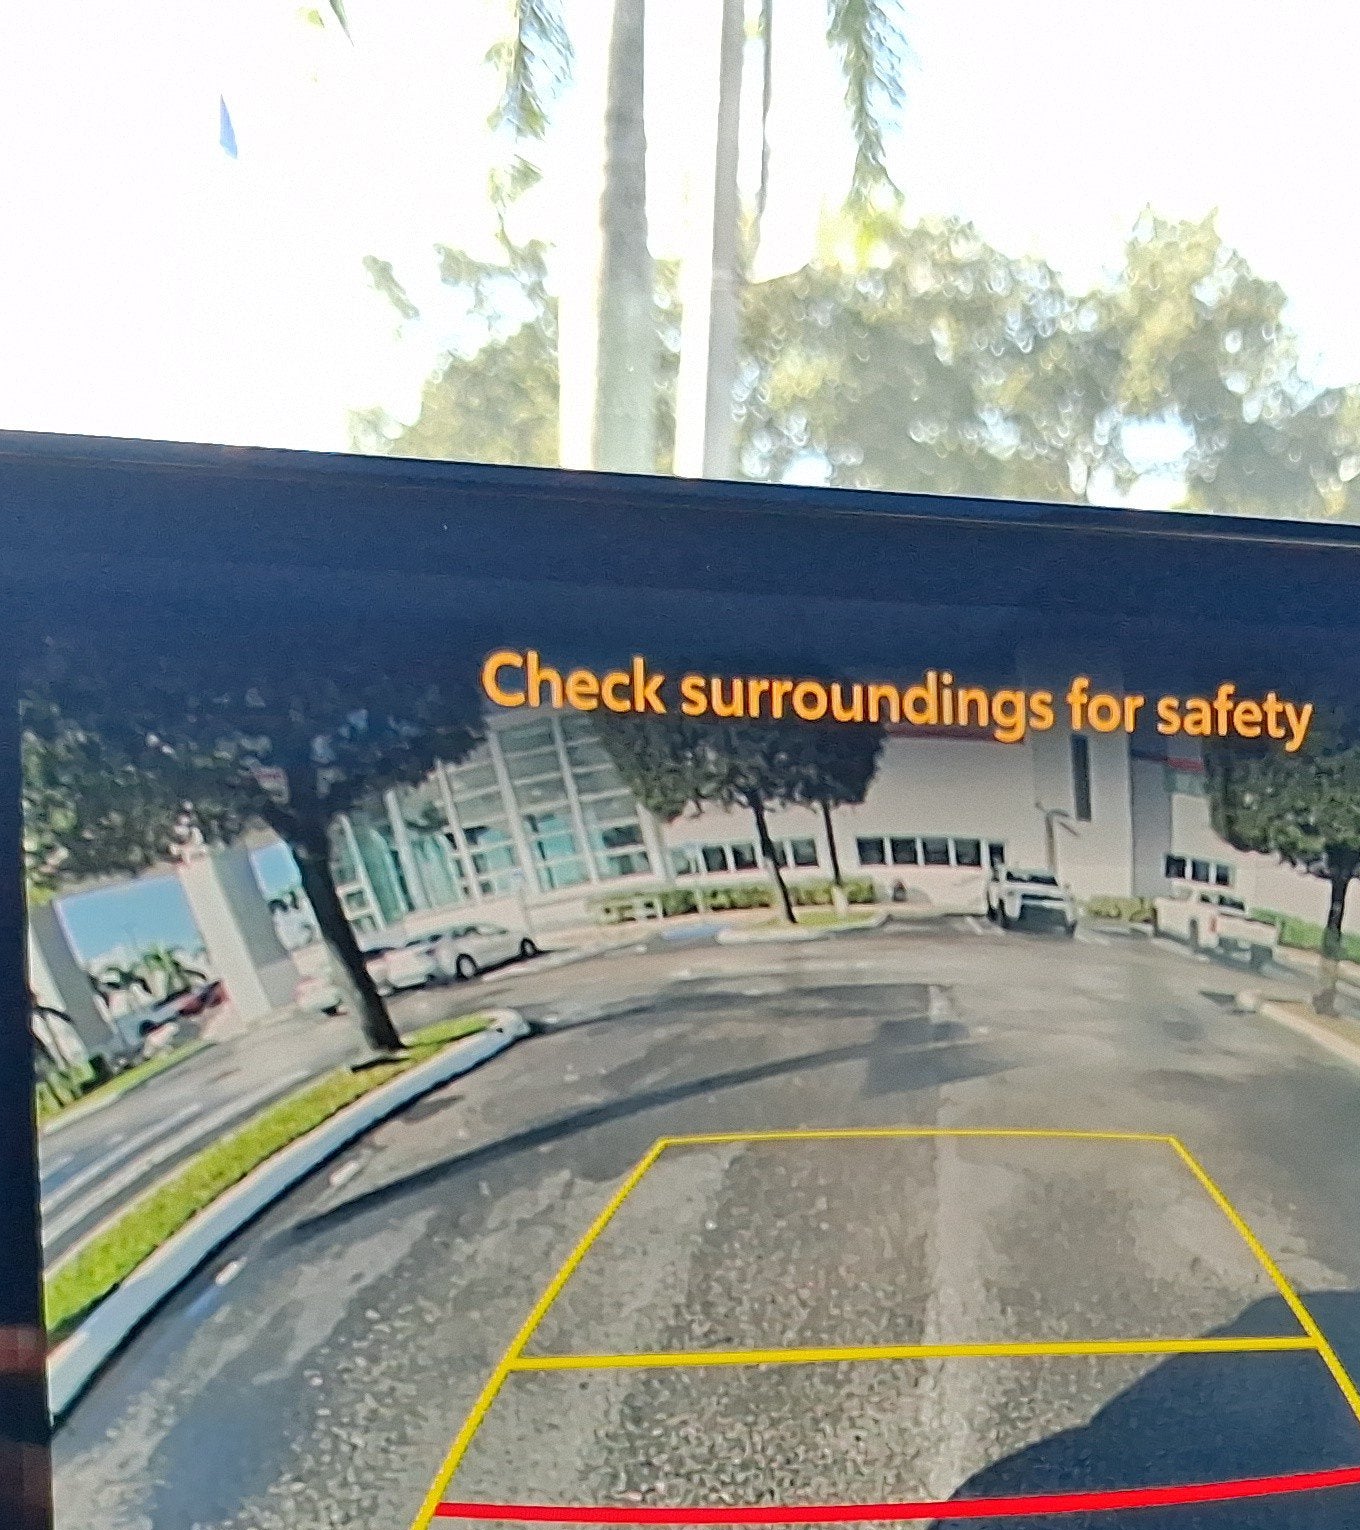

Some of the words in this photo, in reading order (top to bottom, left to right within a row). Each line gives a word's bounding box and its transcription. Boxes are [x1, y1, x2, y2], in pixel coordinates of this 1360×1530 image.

[482, 649, 667, 714] Check
[680, 669, 1055, 743] surroundings
[1066, 676, 1145, 734] for
[1157, 682, 1314, 753] safety
